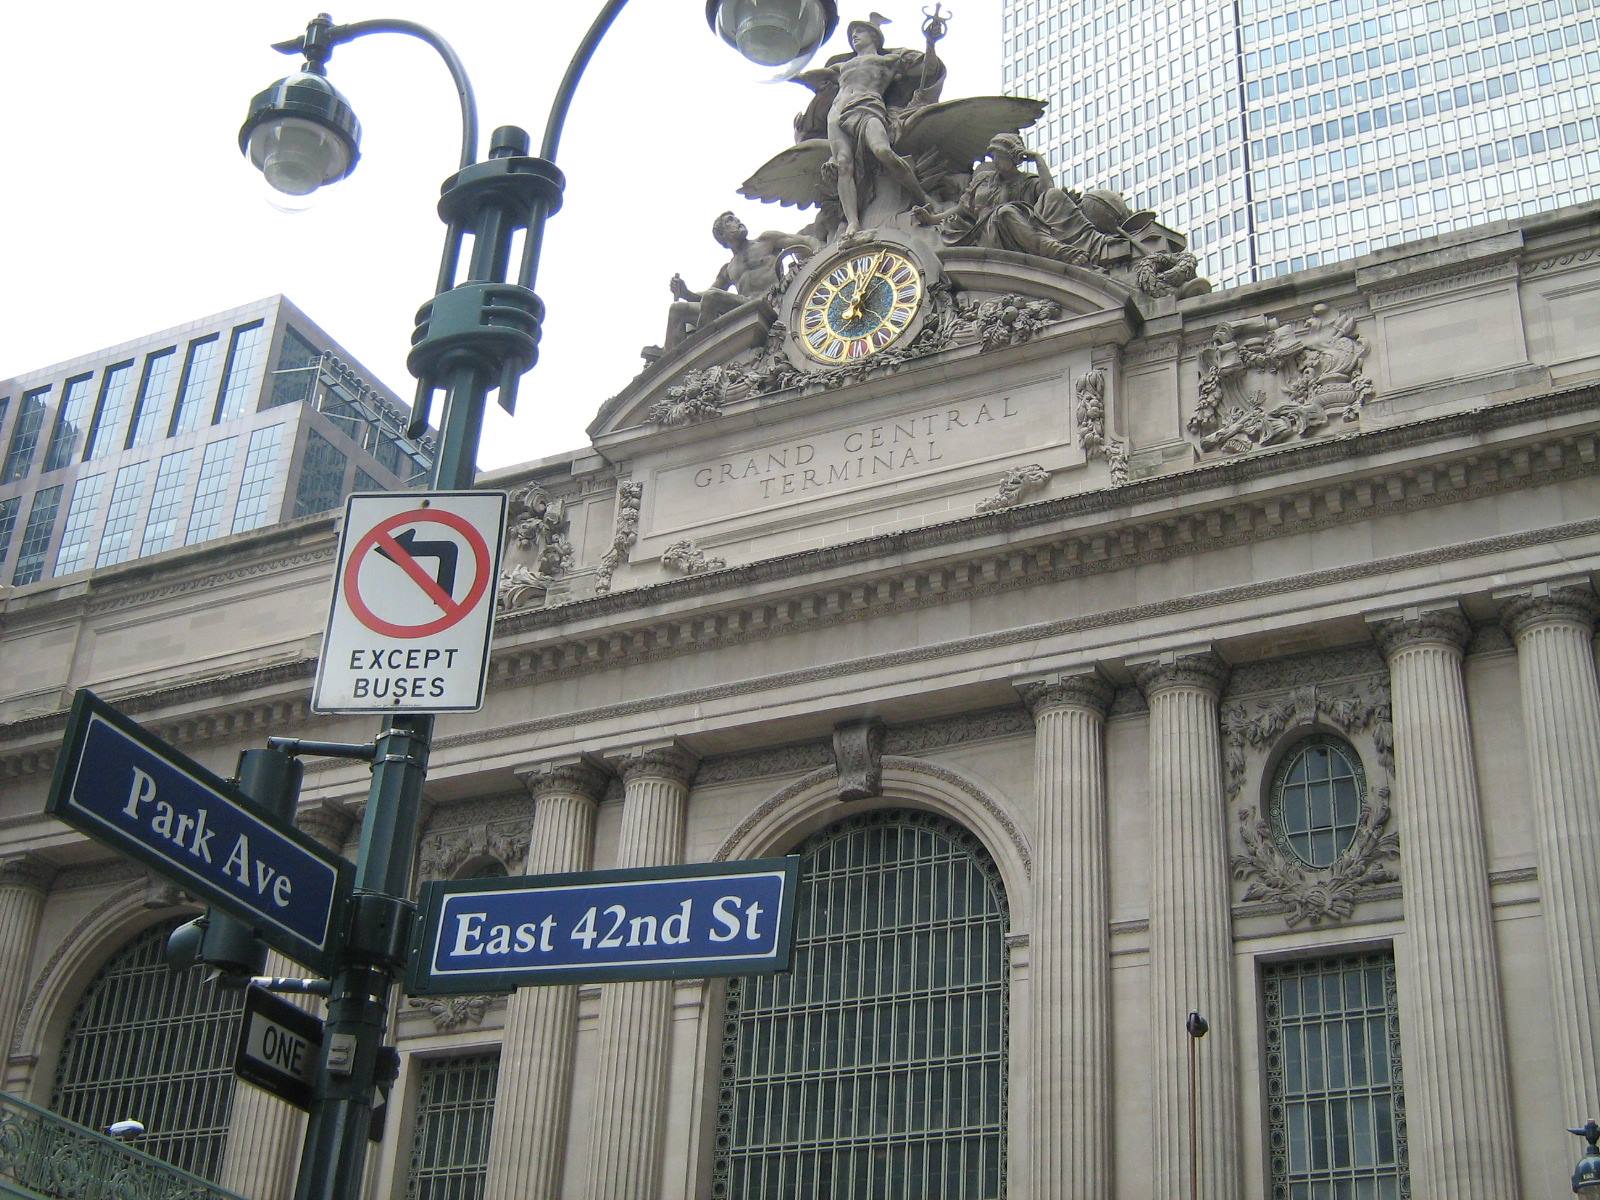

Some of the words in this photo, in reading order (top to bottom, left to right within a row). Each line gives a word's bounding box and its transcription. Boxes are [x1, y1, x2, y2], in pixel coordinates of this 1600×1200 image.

[694, 444, 815, 488] GRAND
[843, 397, 1018, 453] CENTRAL
[759, 441, 943, 499] TERMINAL
[350, 648, 459, 670] EXCEPT
[352, 677, 446, 698] BUSES
[122, 765, 216, 864] Park
[222, 833, 292, 908] Ave
[450, 913, 557, 957] East
[570, 898, 693, 949] 42nd
[709, 895, 764, 942] St
[262, 1025, 307, 1073] ONE
